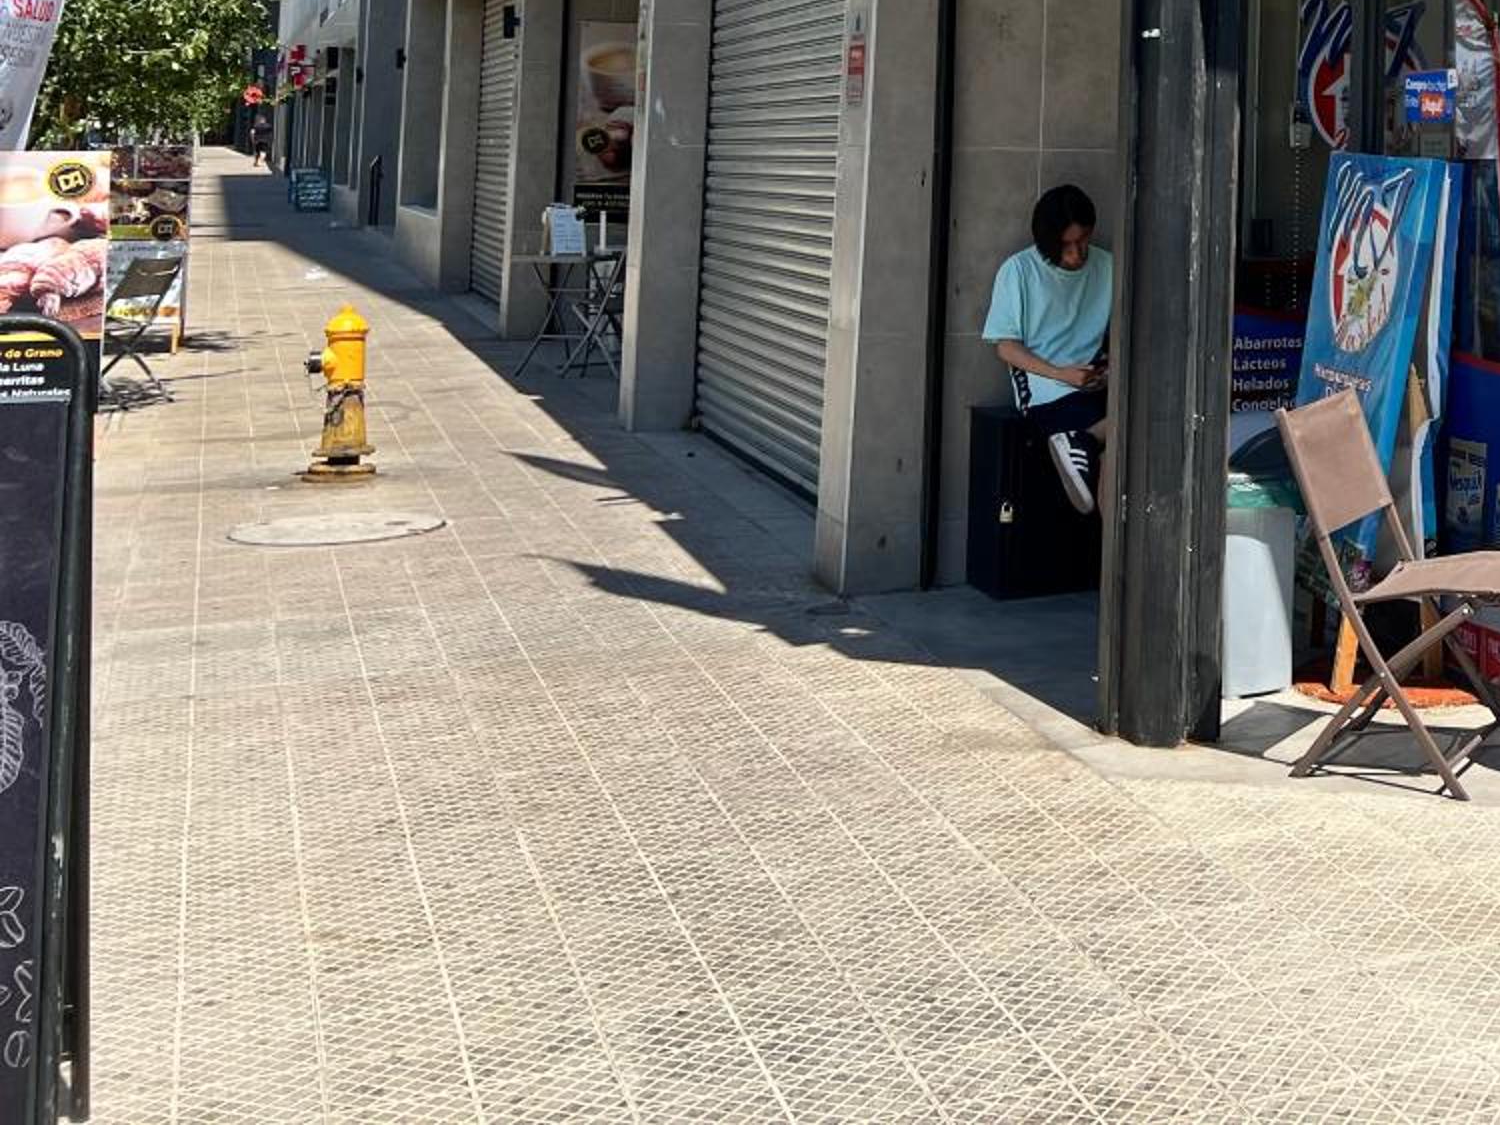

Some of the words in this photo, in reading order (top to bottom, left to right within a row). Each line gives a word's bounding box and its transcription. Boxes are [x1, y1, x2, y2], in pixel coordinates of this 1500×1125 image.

[1233, 336, 1301, 350] Abarrotes
[12, 362, 45, 373] Luna
[1233, 356, 1287, 371] Lácteos
[1233, 376, 1289, 392] Helados
